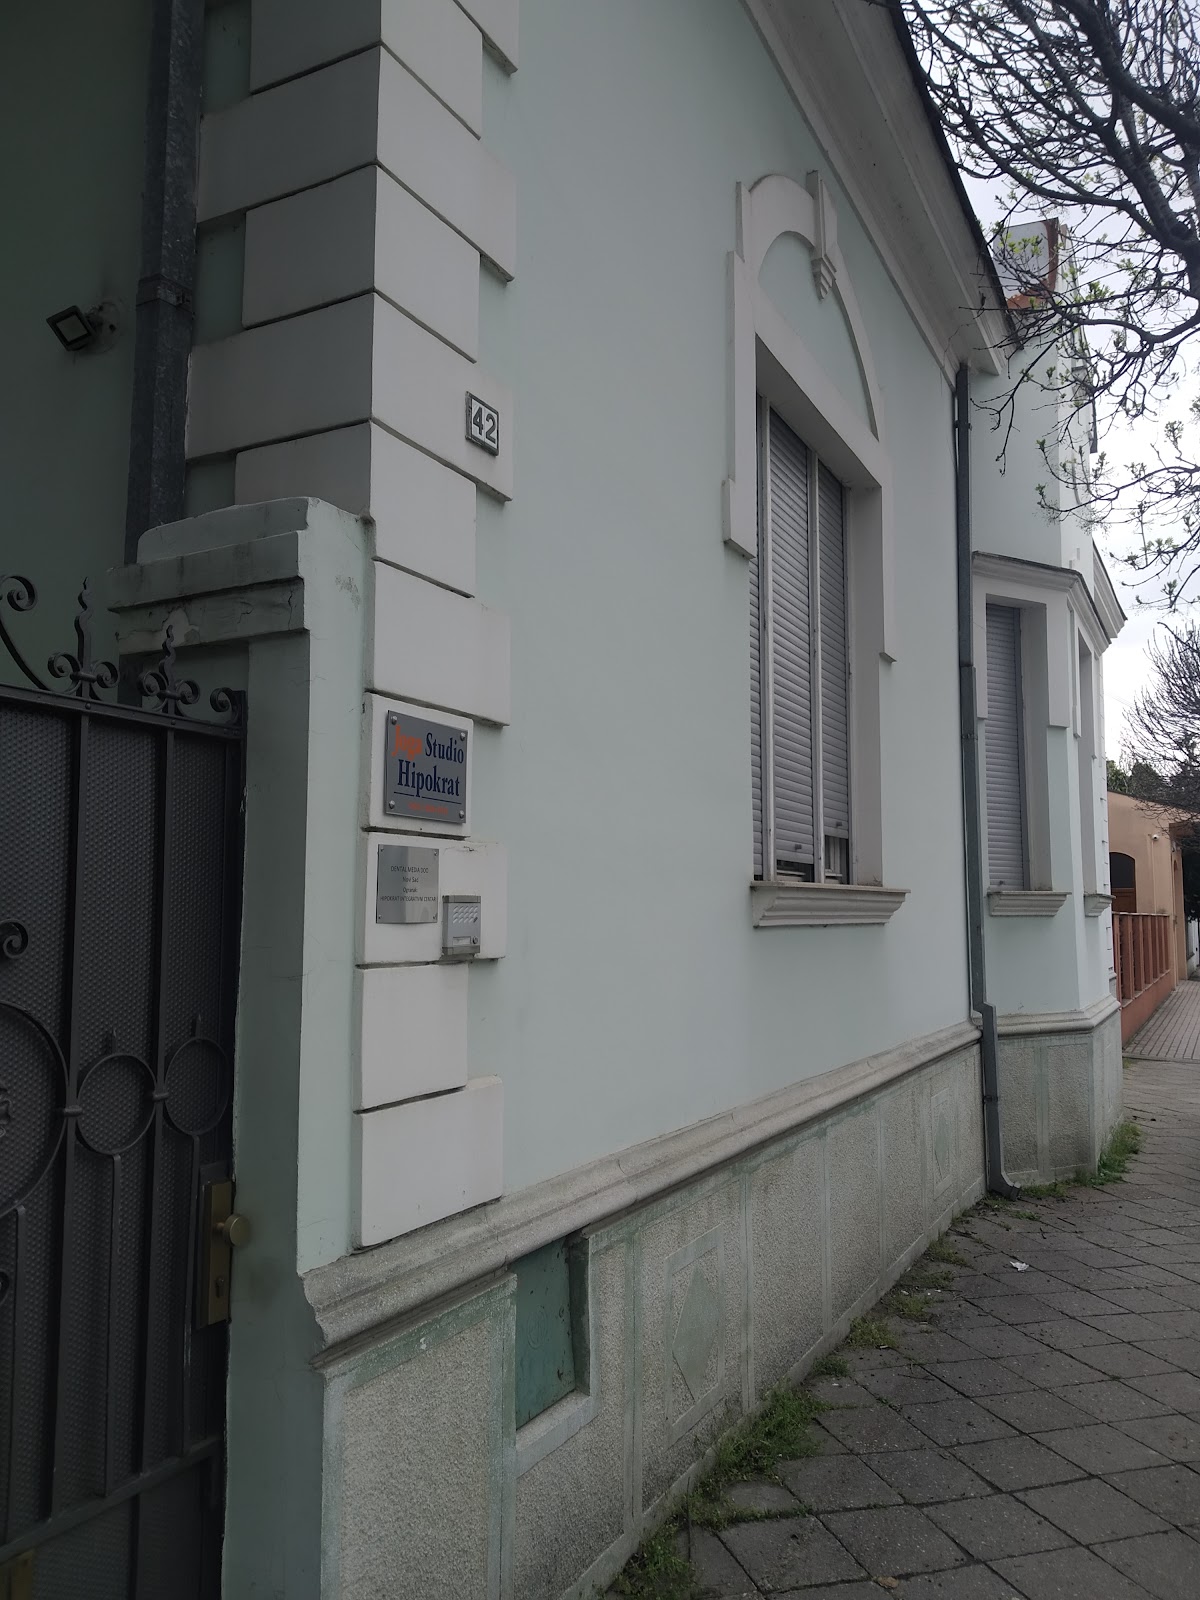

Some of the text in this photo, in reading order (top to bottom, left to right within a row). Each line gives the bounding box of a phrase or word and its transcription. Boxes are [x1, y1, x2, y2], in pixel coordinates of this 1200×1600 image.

[472, 406, 497, 445] 42
[425, 732, 464, 764] Studio
[397, 759, 460, 798] Hipokrat
